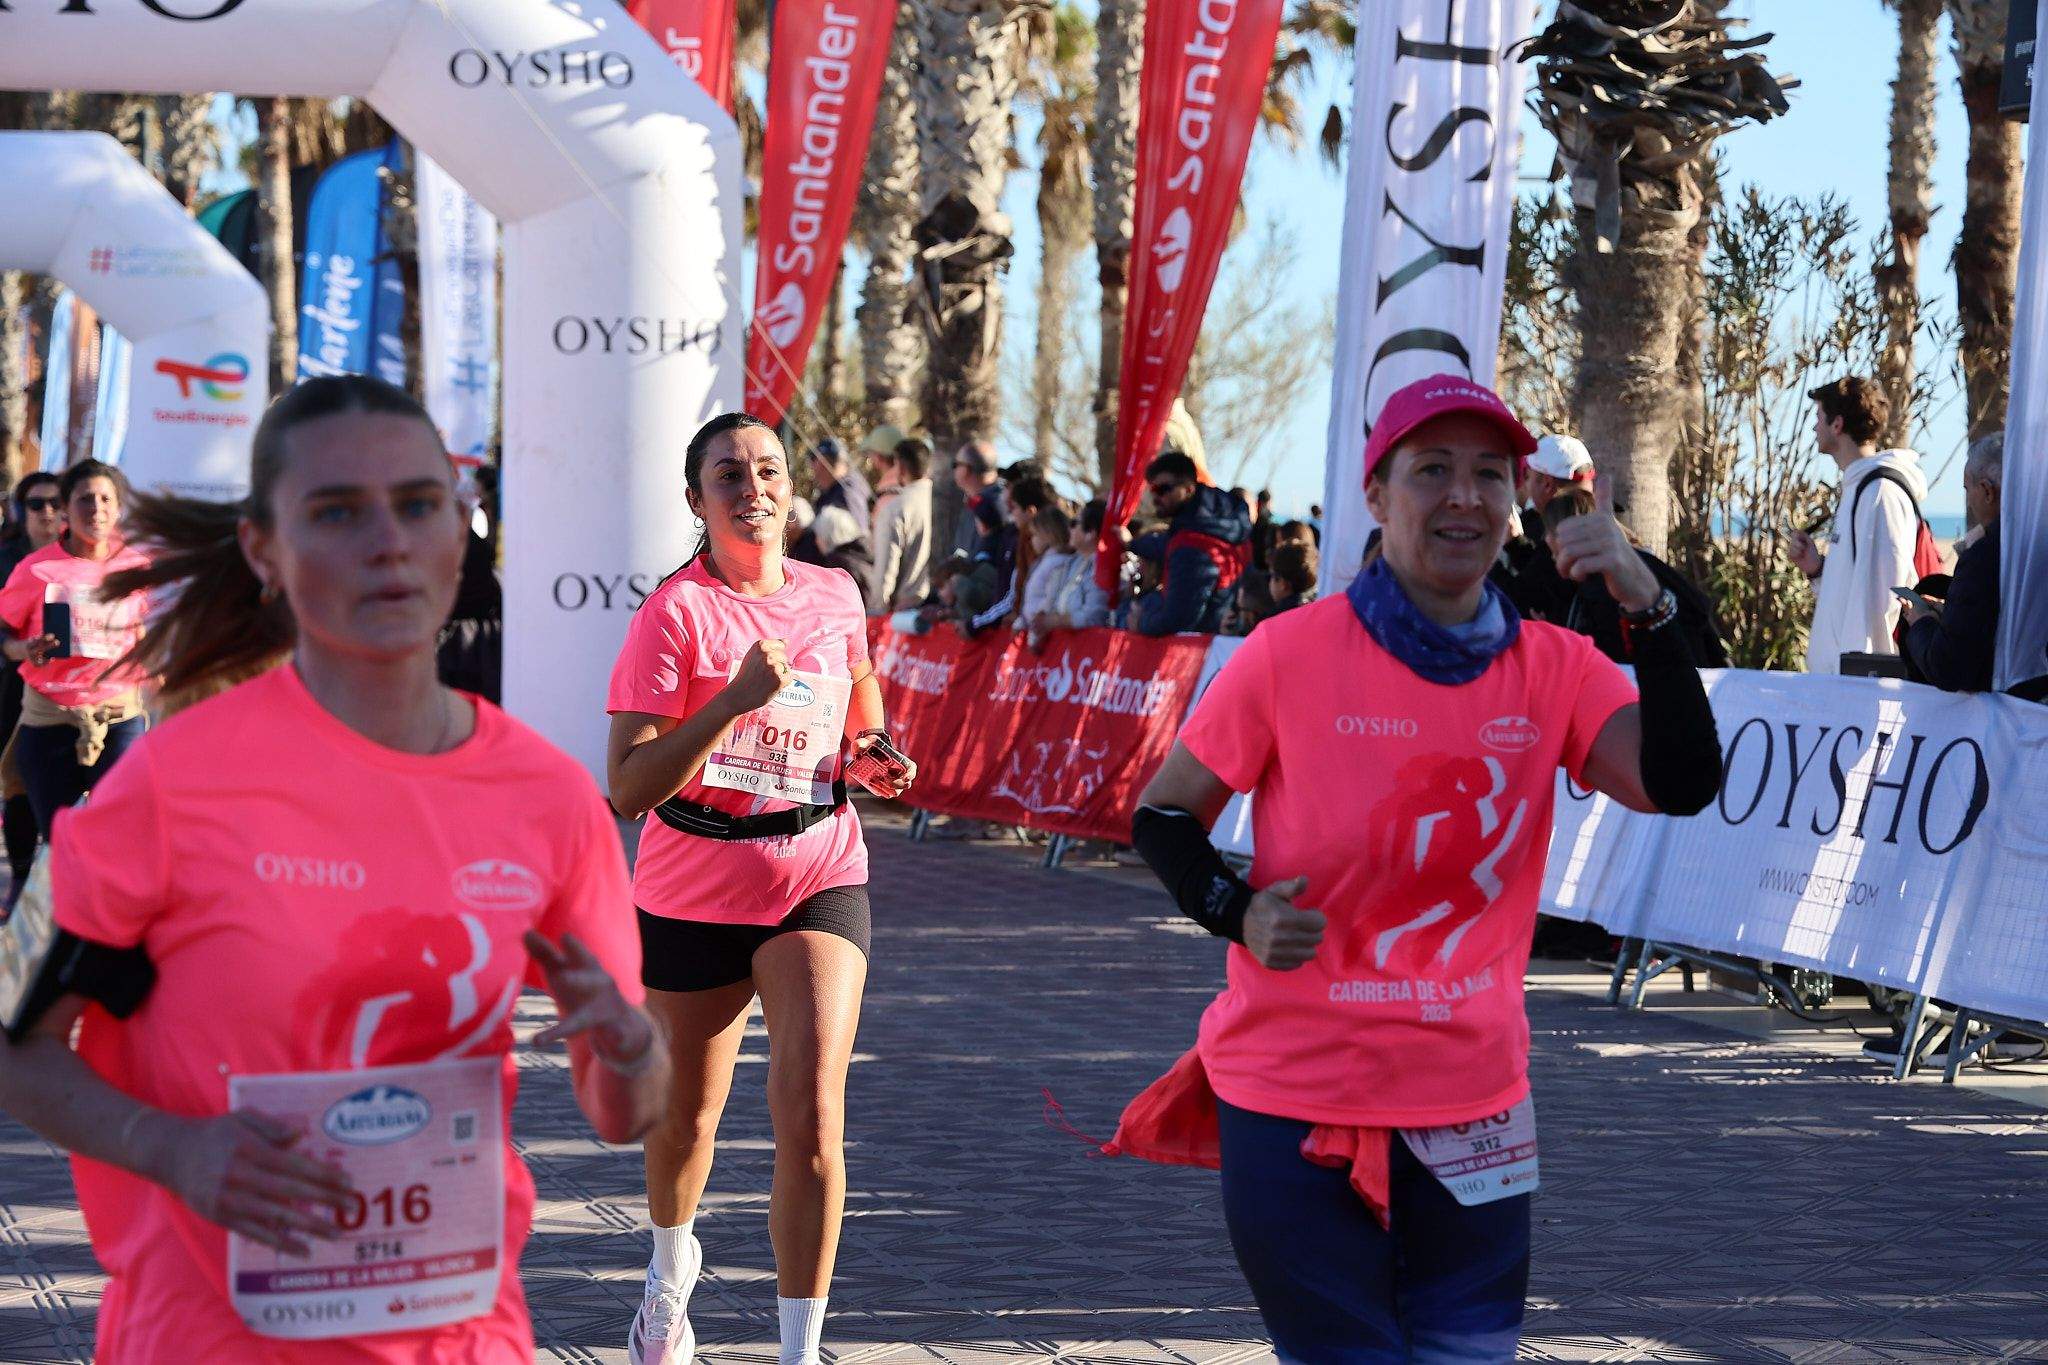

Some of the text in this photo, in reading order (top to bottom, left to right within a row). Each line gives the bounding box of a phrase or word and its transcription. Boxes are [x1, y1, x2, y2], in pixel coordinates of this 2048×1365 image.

[450, 48, 634, 90] OYSHO
[1167, 0, 1239, 195] Santa
[774, 2, 860, 277] Santander
[553, 314, 723, 356] OYSHO
[553, 571, 662, 611] OYS
[1069, 656, 1178, 717] Santander
[761, 726, 808, 751] 016
[1335, 714, 1418, 738] OYSHO
[725, 757, 751, 768] CARRERA
[762, 763, 770, 771] LA
[769, 752, 788, 763] 935
[718, 770, 760, 786] OYSHO
[1718, 717, 1990, 855] OYSHO
[774, 845, 797, 858] 2025
[254, 852, 366, 891] OYSHO
[1329, 980, 1412, 1002] CARRERA
[1415, 980, 1438, 1000] DE
[1439, 982, 1463, 1000] LA
[1421, 1003, 1452, 1022] 2025
[1470, 1136, 1502, 1154] 3812
[334, 1184, 432, 1232] 016
[262, 1301, 356, 1325] OYSHO
